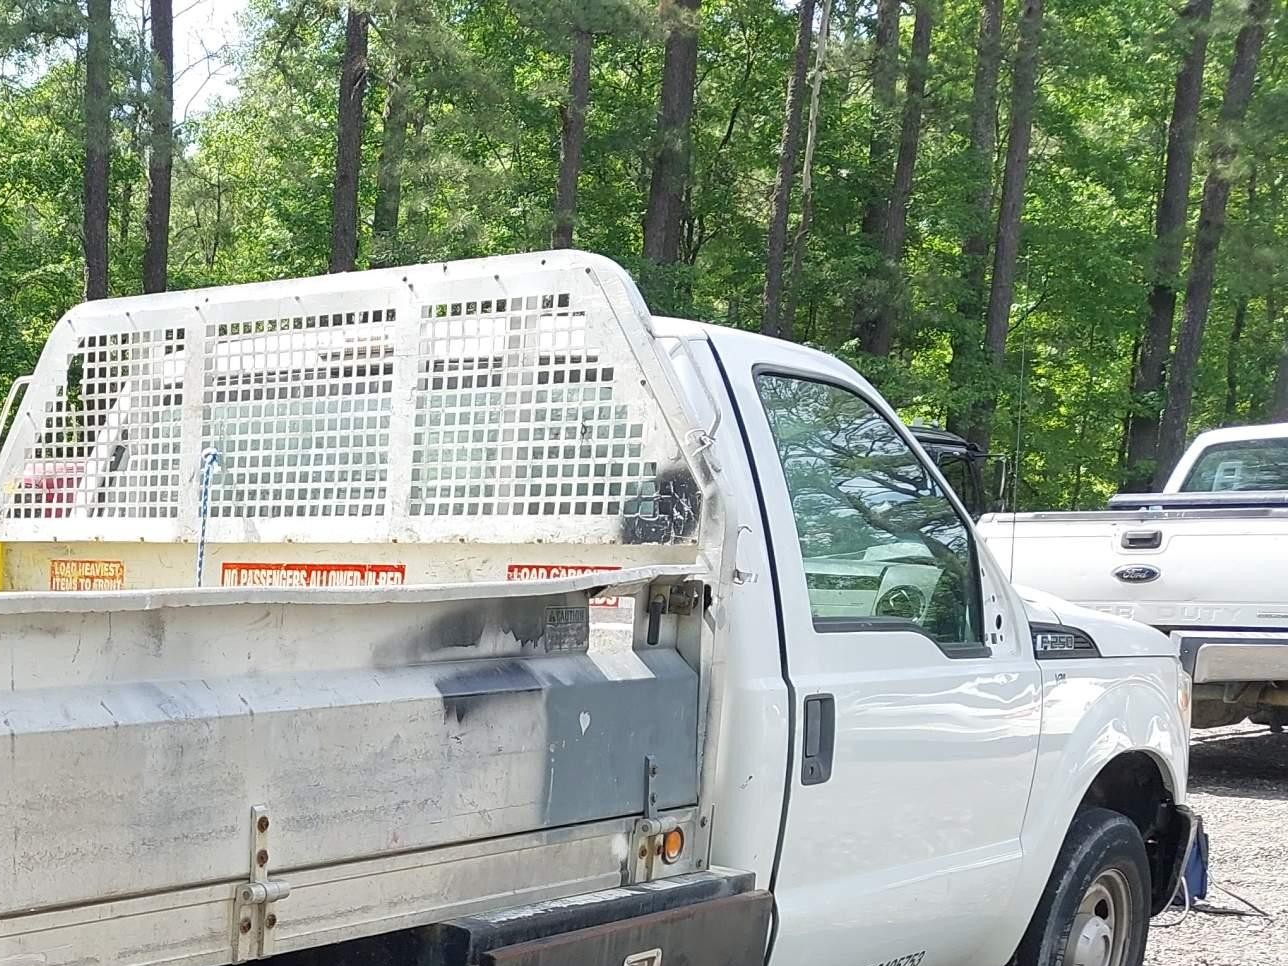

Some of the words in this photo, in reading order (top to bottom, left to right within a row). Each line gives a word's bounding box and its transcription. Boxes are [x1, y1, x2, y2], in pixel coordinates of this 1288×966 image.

[54, 562, 76, 577] LOAD
[78, 562, 121, 577] HEAVIEST
[514, 567, 547, 580] LOAD
[52, 577, 77, 591] ITEMS
[79, 578, 91, 591] TO
[224, 568, 238, 587] NO
[240, 568, 308, 587] PASSENGERS
[310, 570, 361, 587] ALLOWED
[556, 608, 585, 621] CAUTION
